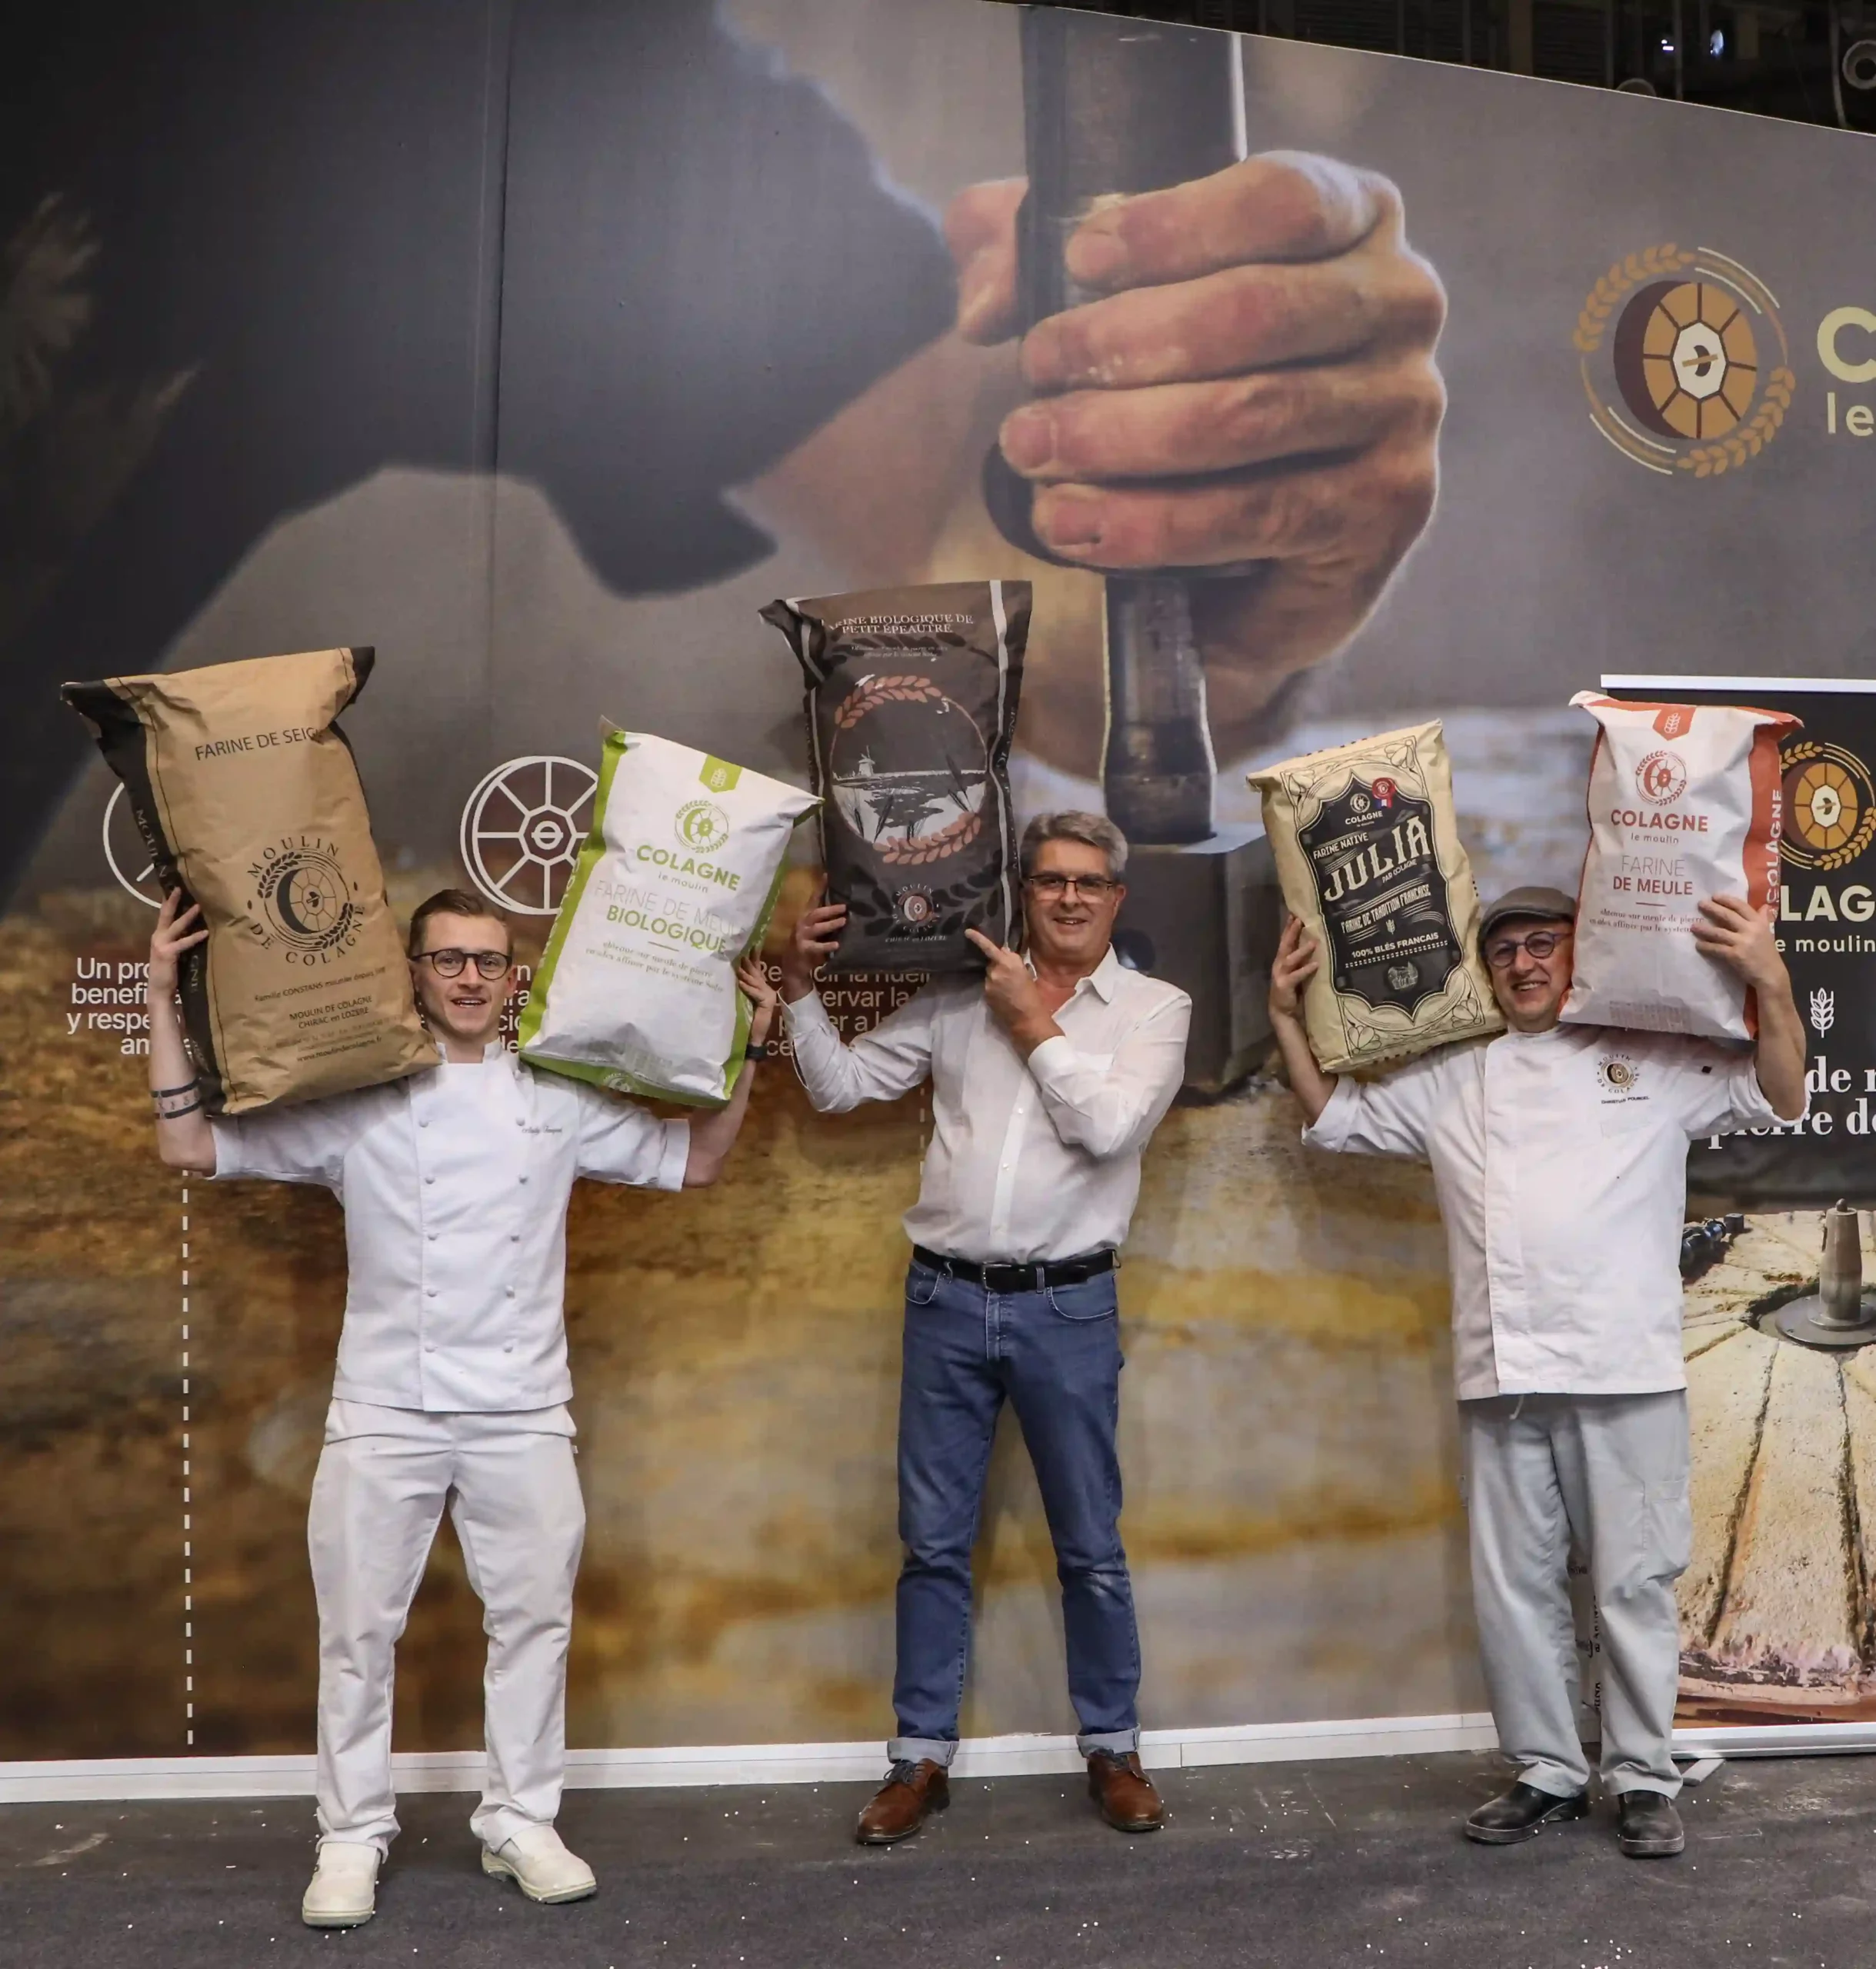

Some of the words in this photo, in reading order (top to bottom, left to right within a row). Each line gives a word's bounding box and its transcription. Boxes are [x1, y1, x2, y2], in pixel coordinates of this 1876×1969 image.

[1828, 392, 1874, 436] le
[842, 625, 880, 634] PETIT
[870, 615, 953, 625] BIOLOGIQUE
[955, 614, 974, 625] DE
[195, 737, 254, 761] FARINE
[256, 732, 280, 748] DE
[283, 728, 318, 745] SEIG
[1345, 811, 1383, 825] COLAGNE
[1611, 809, 1708, 832] COLAGNE
[1313, 842, 1339, 860] FARINE
[1340, 832, 1369, 849] NATIVE
[1644, 835, 1679, 844] moulin
[247, 835, 339, 878] MOULIN
[1324, 815, 1431, 901] JULIA
[1621, 855, 1685, 877] FARINE
[637, 845, 741, 891] COLAGNE
[1382, 873, 1393, 884] PAR
[1393, 858, 1418, 875] COLAGNE
[658, 871, 669, 881] le
[671, 878, 708, 893] moulin
[1613, 876, 1631, 891] DE
[1637, 878, 1693, 895] MEULE
[594, 880, 658, 912] FARINE
[663, 898, 690, 920] DE
[694, 907, 746, 937] MEUL
[1341, 916, 1363, 934] FARINE
[1362, 913, 1371, 926] DE
[1371, 897, 1401, 922] TRADITION
[250, 923, 274, 950] DE
[285, 905, 365, 966] COLAGNE
[606, 905, 726, 955] BIOLOGIQUE
[1351, 948, 1373, 958] 100%
[1375, 942, 1396, 953] BLÉS
[1775, 938, 1786, 952] e
[1795, 935, 1876, 952] moulin
[77, 957, 111, 979] Un
[72, 982, 148, 1004] benefi
[282, 981, 323, 997] CONSTANS
[289, 1008, 323, 1021] MOULIN
[325, 1004, 336, 1013] DE
[338, 995, 372, 1010] COLAGNE
[66, 1012, 82, 1034] y
[88, 1012, 150, 1034] respe
[298, 1016, 330, 1029] CHIRAC
[855, 1015, 868, 1031] a
[1805, 1056, 1852, 1093] de
[1846, 1098, 1876, 1135] d
